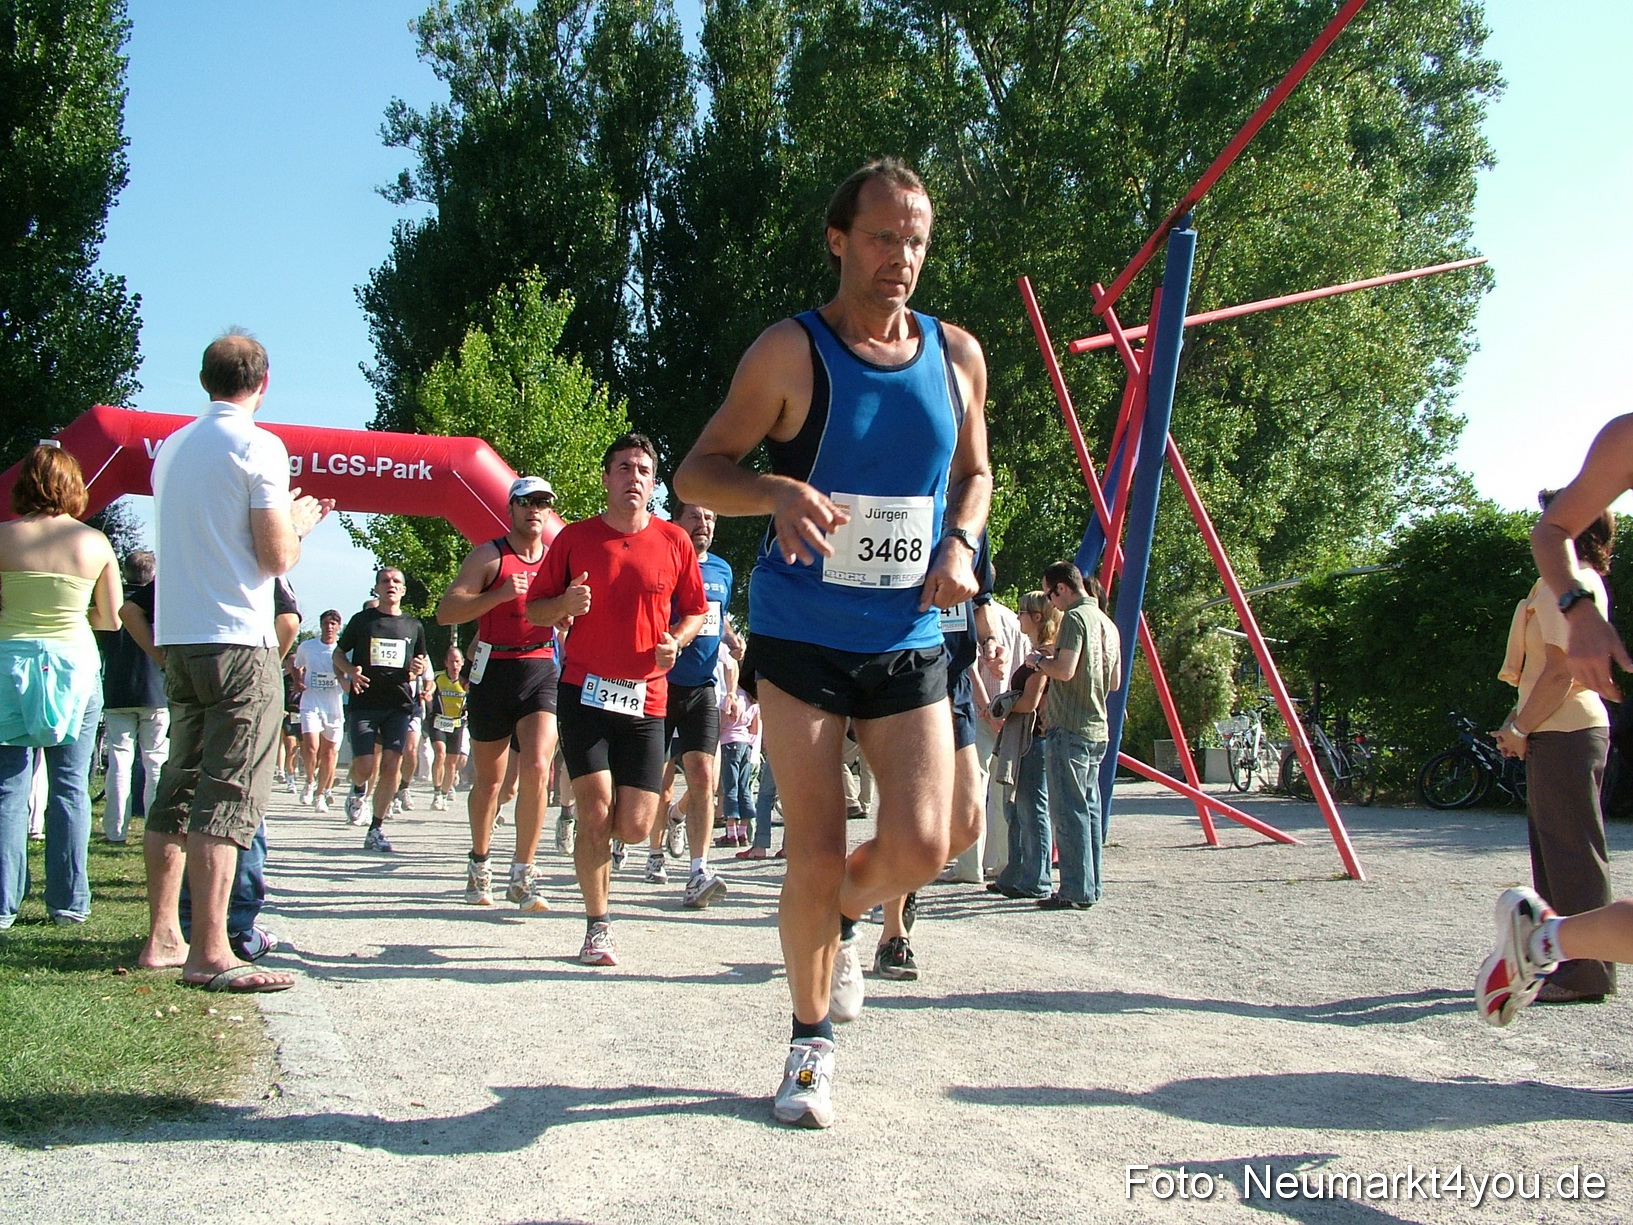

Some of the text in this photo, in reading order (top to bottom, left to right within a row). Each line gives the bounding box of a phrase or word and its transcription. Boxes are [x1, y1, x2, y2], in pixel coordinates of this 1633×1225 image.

[311, 452, 433, 481] LGS-Park
[865, 508, 908, 522] Jürgen
[858, 537, 923, 563] 3468
[380, 650, 397, 659] 152
[586, 682, 594, 691] B
[598, 689, 639, 711] 3118
